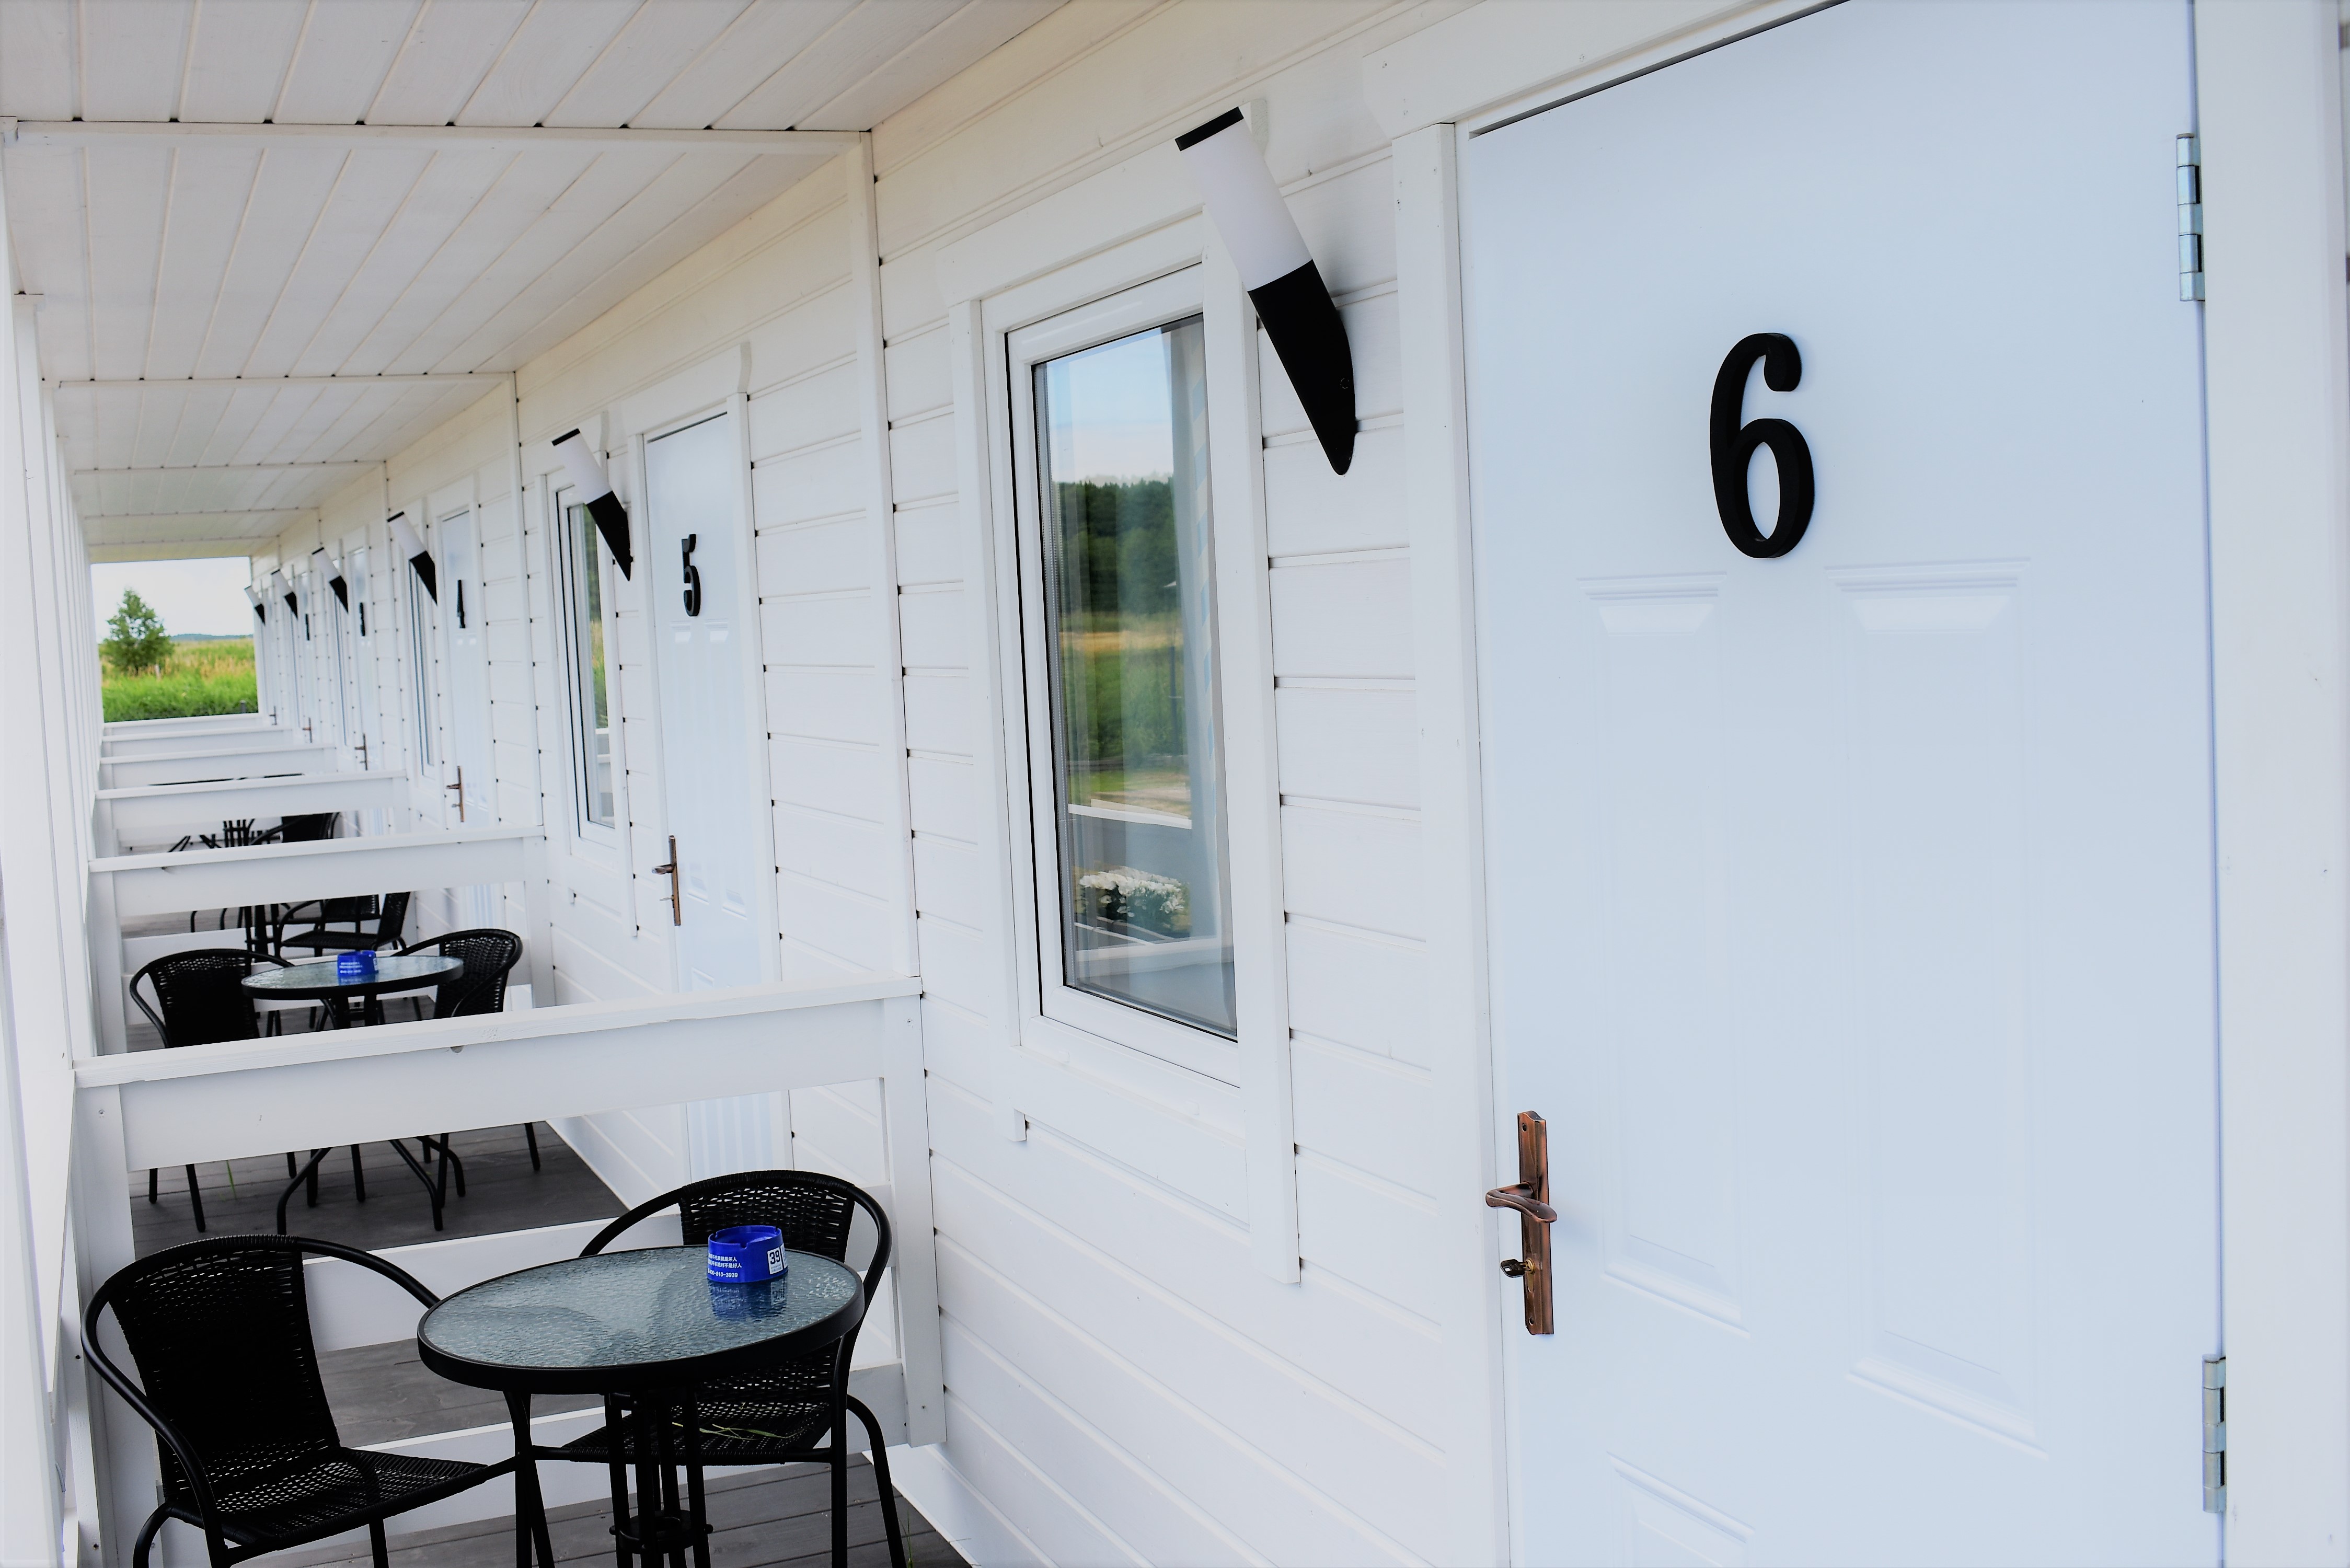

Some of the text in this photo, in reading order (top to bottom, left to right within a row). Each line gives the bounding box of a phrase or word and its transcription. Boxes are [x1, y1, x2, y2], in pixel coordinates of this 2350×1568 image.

[1710, 332, 1814, 558] 6
[682, 534, 700, 616] 5
[769, 1250, 780, 1264] 39
